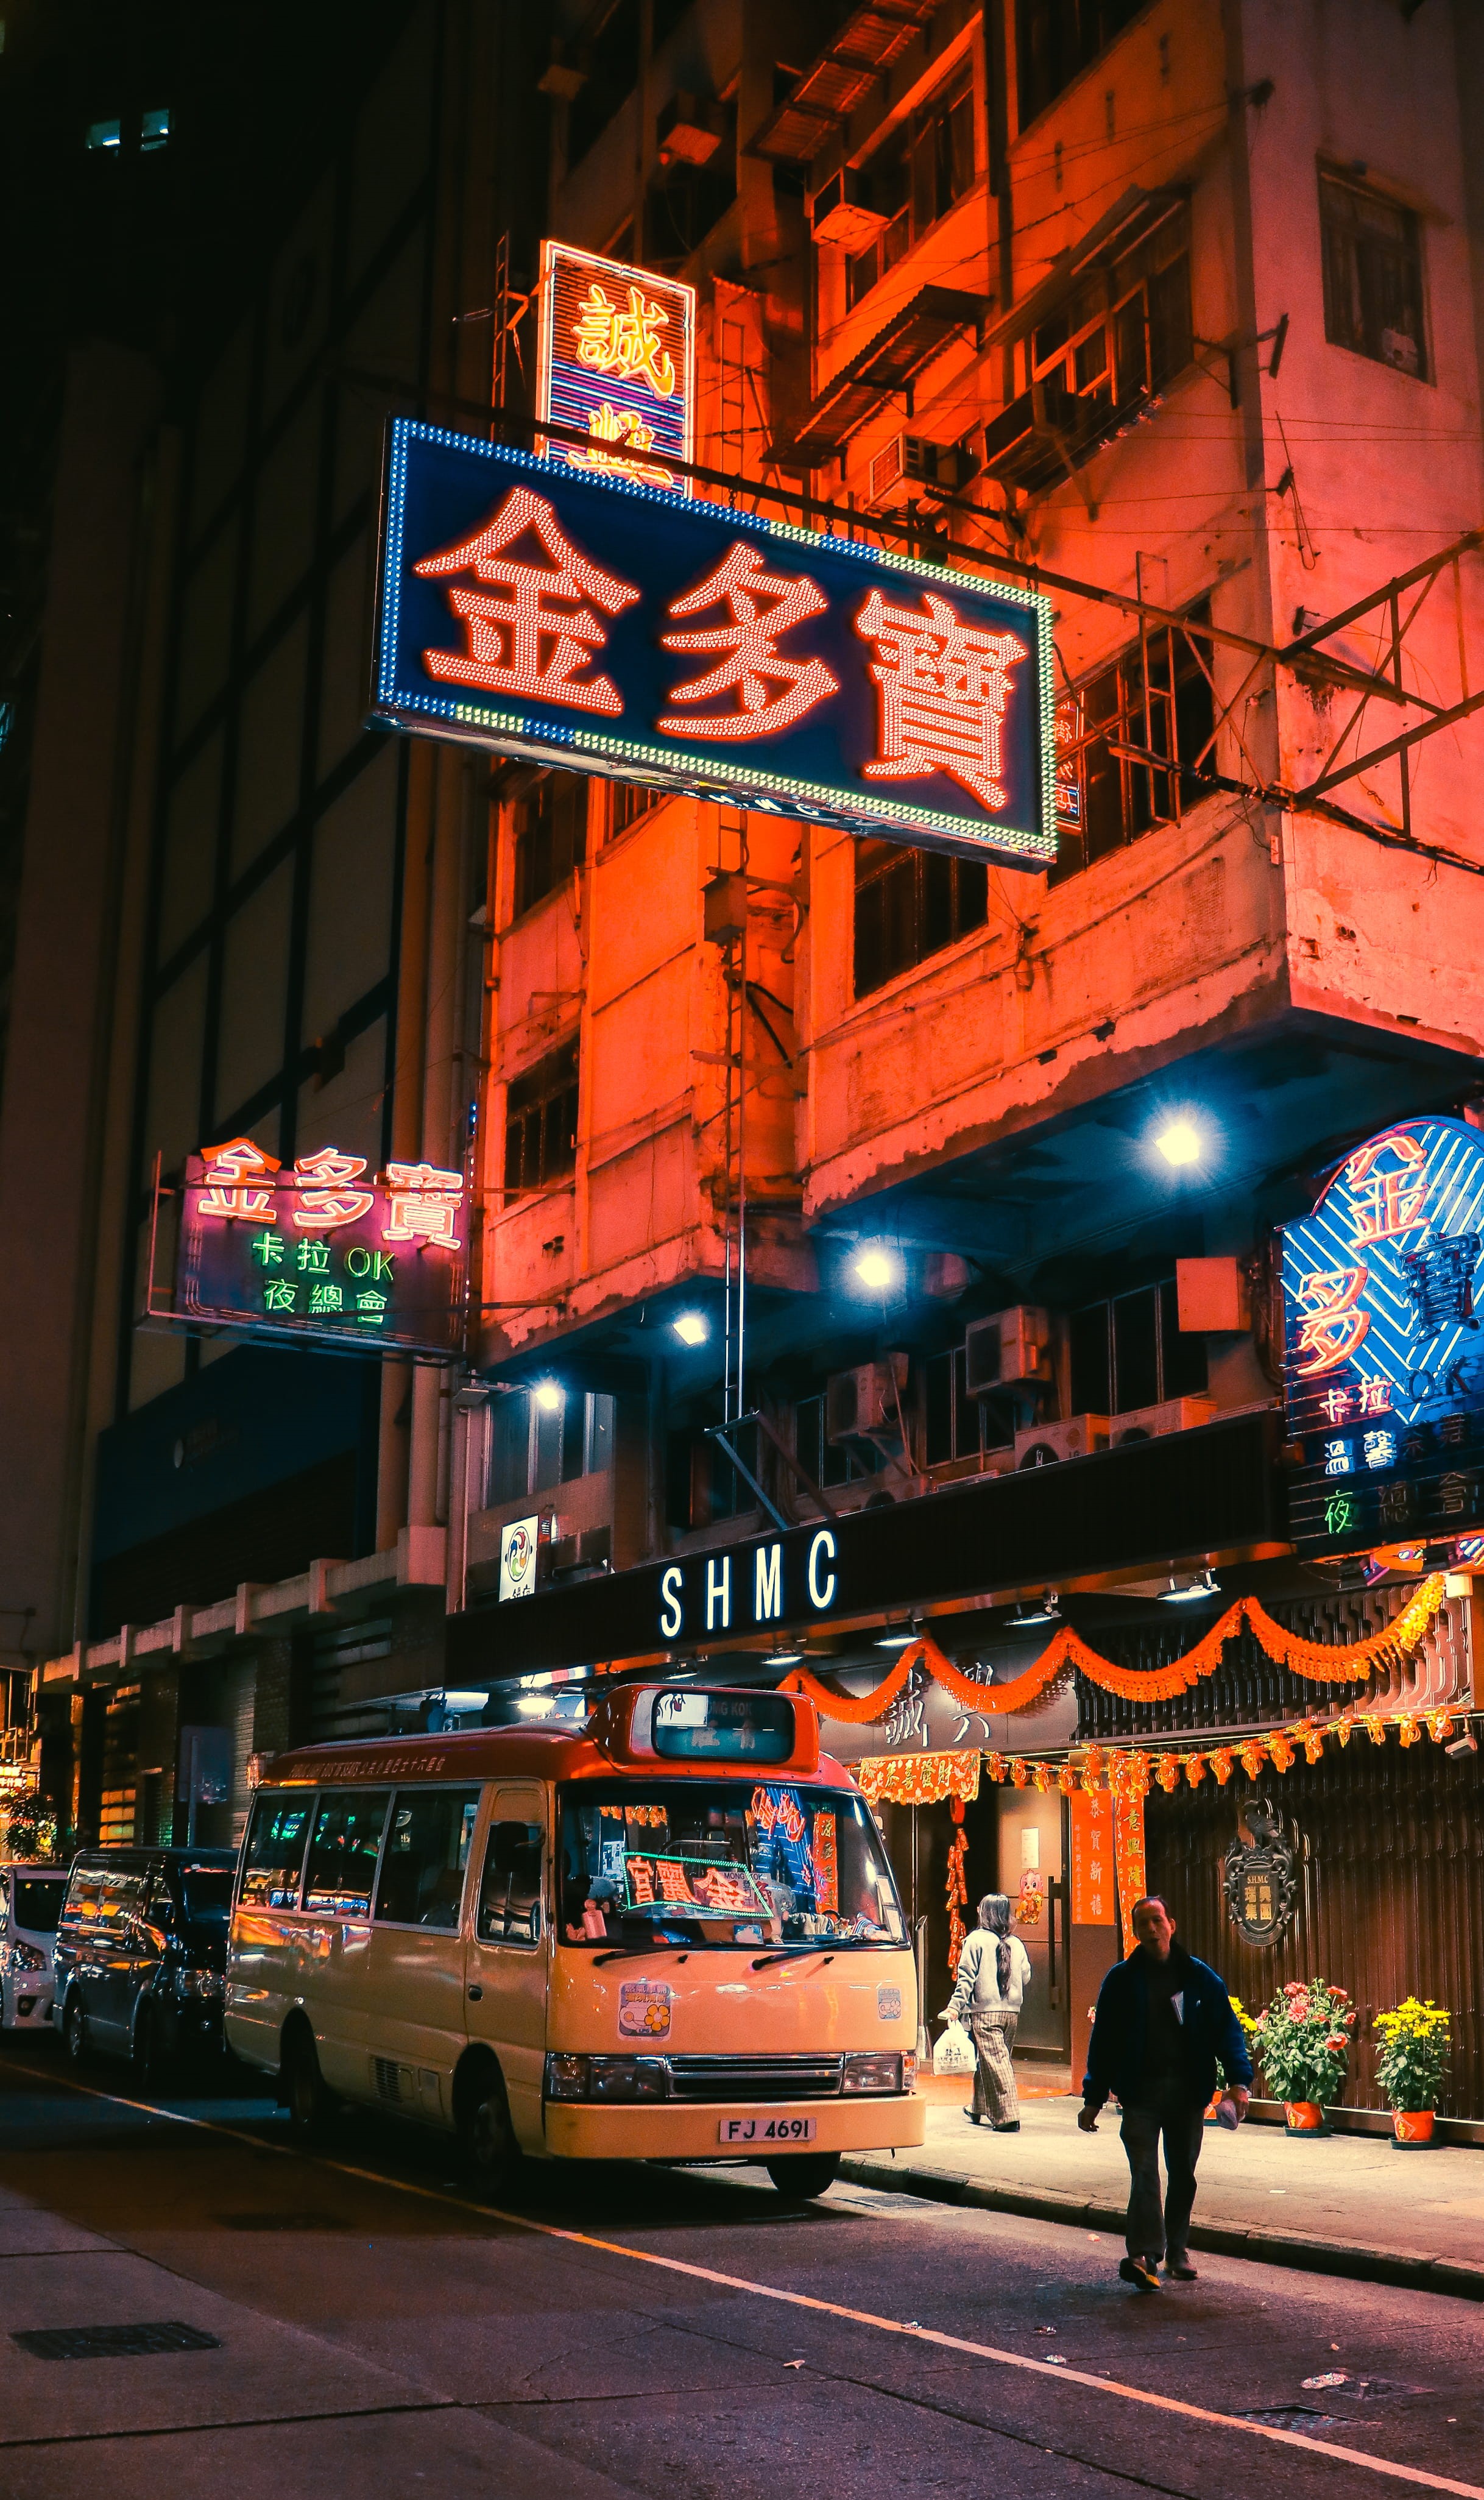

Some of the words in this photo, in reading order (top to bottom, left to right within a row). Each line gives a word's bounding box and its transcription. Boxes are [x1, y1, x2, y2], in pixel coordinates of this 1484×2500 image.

[412, 486, 1028, 812] 金多寶
[198, 1137, 463, 1250] 金多寶
[252, 1231, 395, 1281] 卡拉OK
[264, 1280, 387, 1325] 夜總會
[662, 1531, 835, 1637] SHMC
[885, 1758, 953, 1792] 恭喜發財
[1090, 1798, 1104, 1916] 恭賀新禧
[1245, 1903, 1272, 1921] 集團
[729, 2120, 755, 2139] FJ
[765, 2120, 808, 2138] 4691
